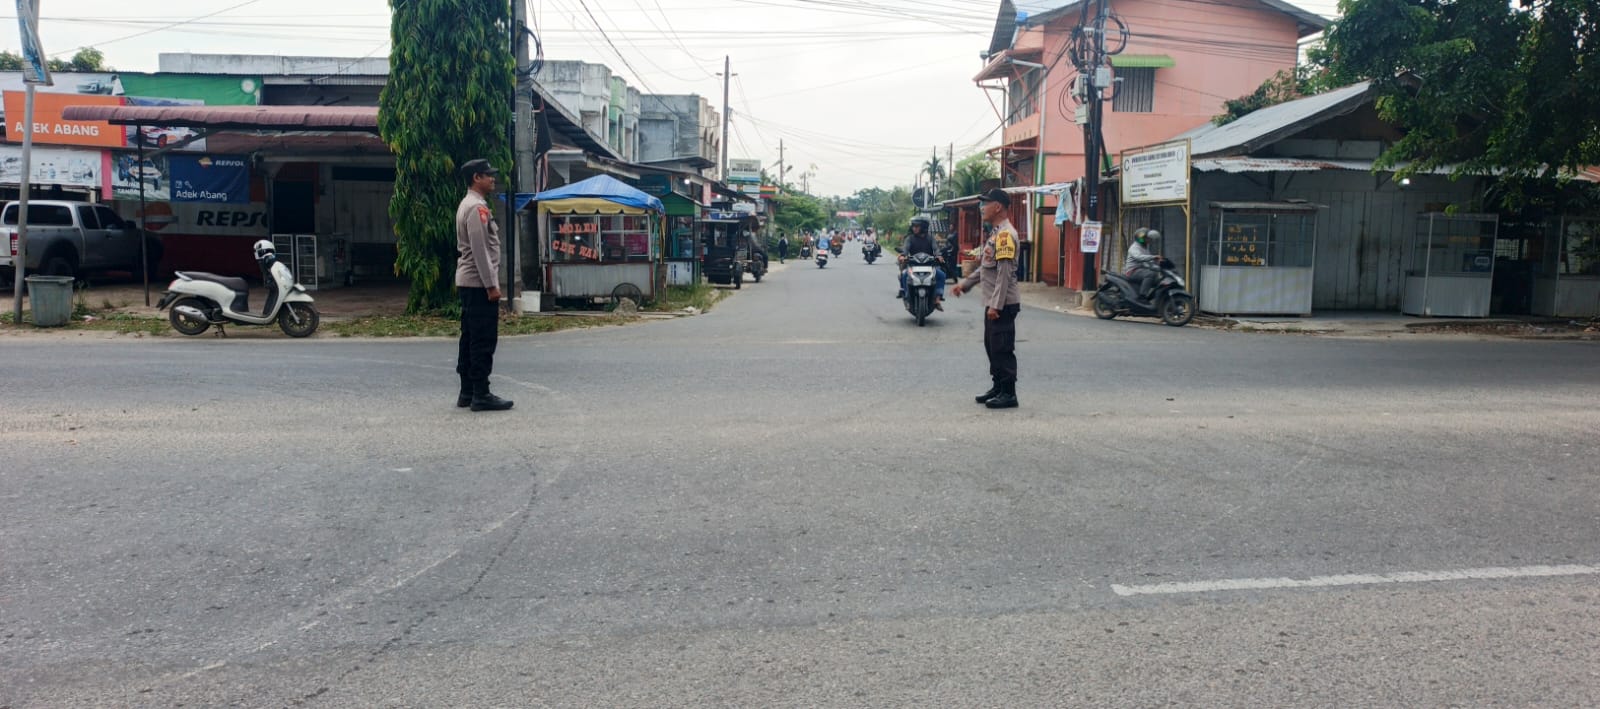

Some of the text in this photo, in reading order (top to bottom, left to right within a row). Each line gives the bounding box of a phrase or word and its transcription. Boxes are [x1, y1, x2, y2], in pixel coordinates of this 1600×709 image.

[15, 121, 99, 136] AEK ABANG
[175, 190, 227, 201] Adek Abang
[559, 223, 597, 234] MOLEN
